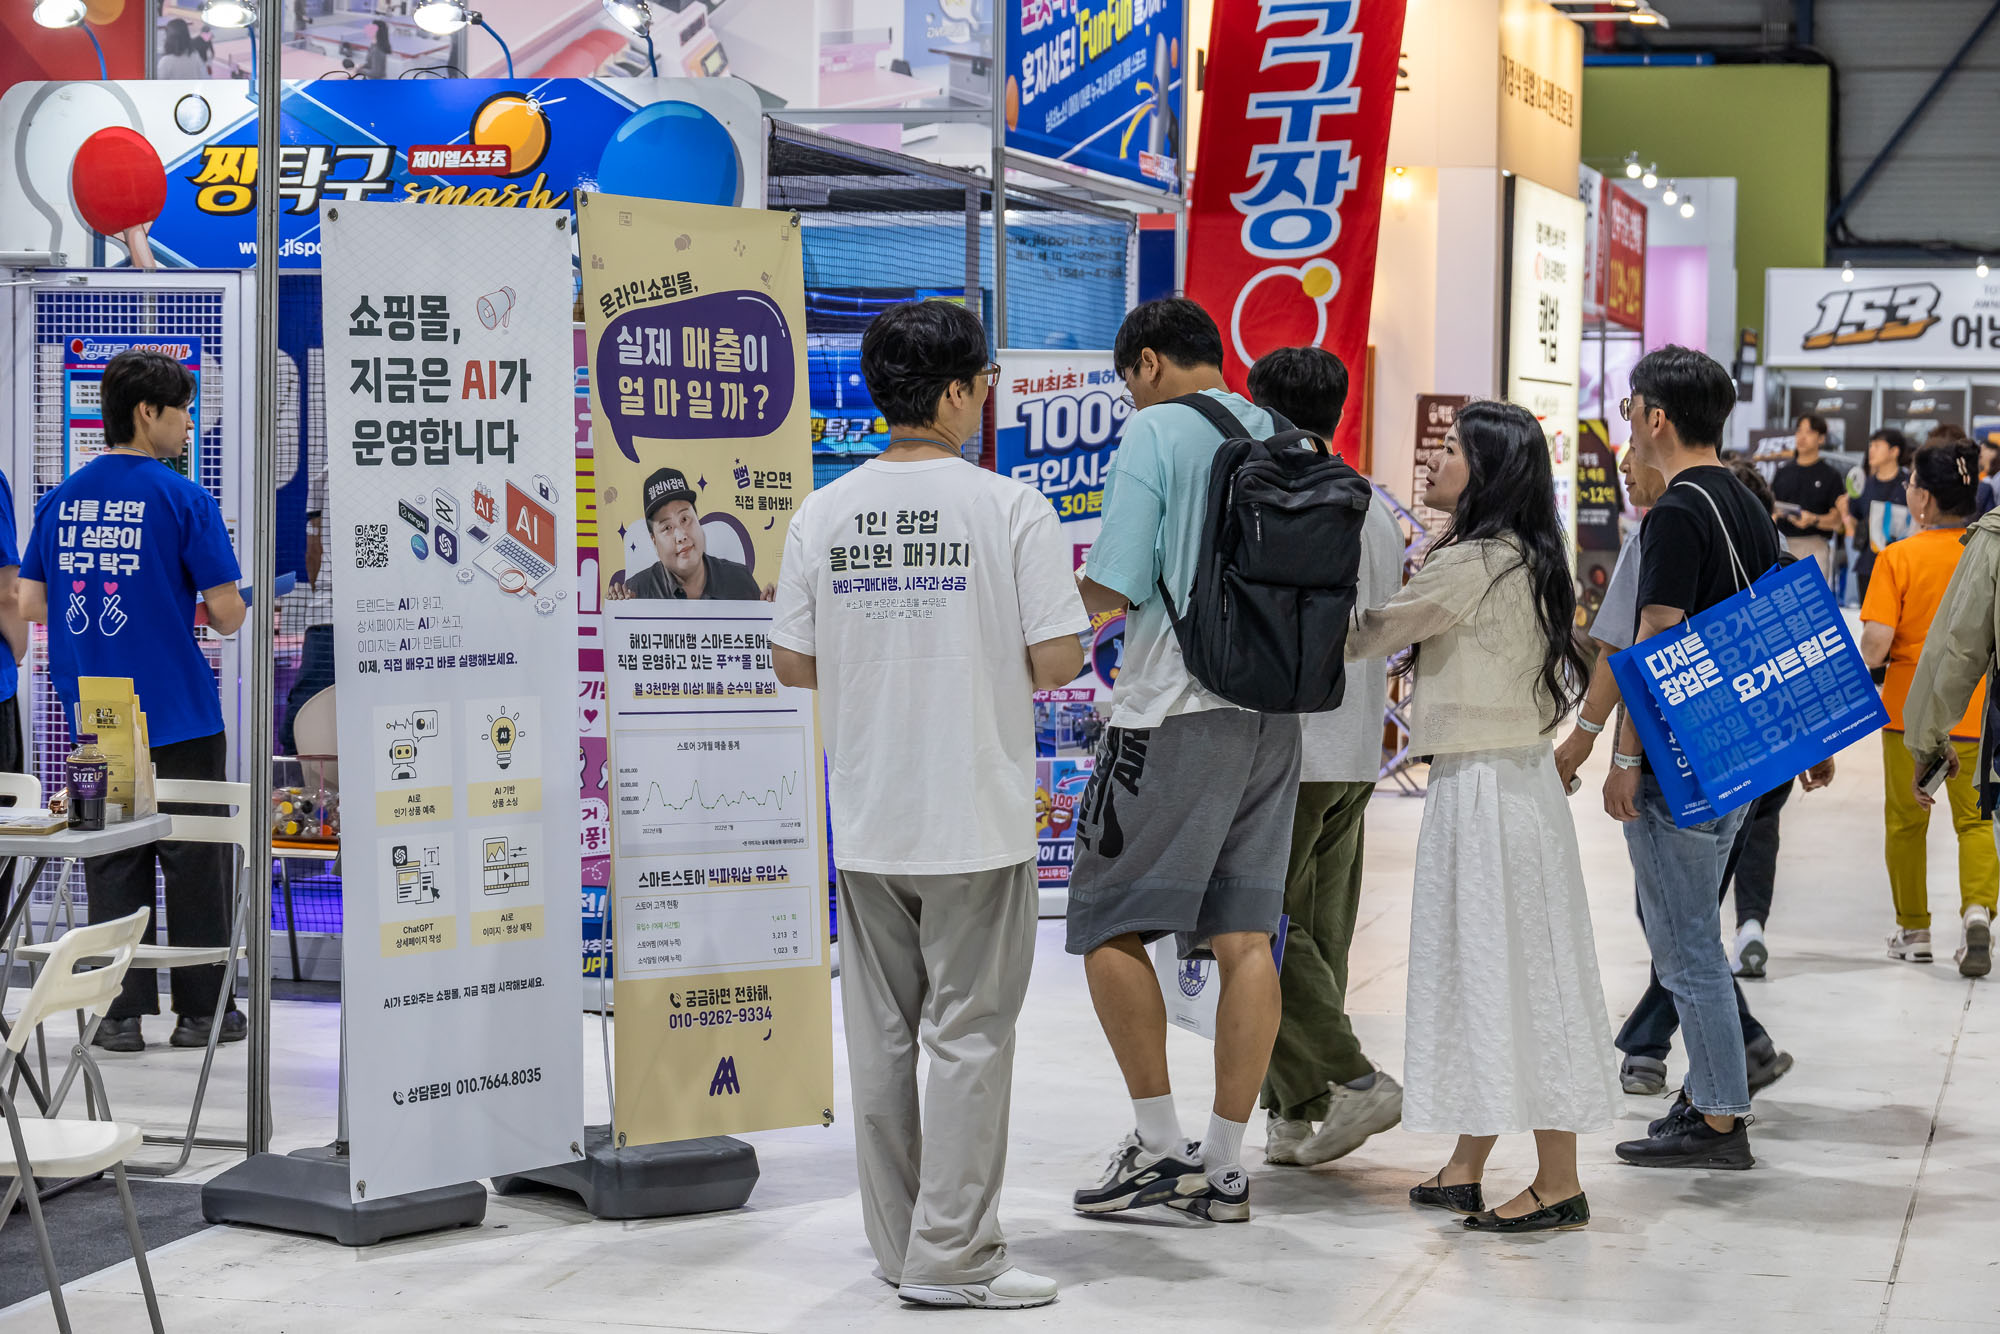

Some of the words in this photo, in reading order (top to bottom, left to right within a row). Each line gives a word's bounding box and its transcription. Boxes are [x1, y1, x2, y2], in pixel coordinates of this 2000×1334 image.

[1022, 26, 1076, 105] 혼자서도!
[411, 148, 507, 169] 제이엘스포츠
[599, 271, 699, 319] 온라인쇼핑몰,
[349, 295, 461, 345] 쇼핑몰,
[1802, 283, 1941, 350] 153
[616, 325, 672, 367] 실제
[682, 326, 768, 374] 매출이
[349, 357, 451, 404] 지금은
[461, 358, 532, 403] AI가
[1012, 371, 1084, 395] 국내최초!
[1087, 369, 1115, 385] 특허
[352, 418, 519, 466] 운영합니다
[648, 478, 686, 500] 월천N잡러
[733, 464, 751, 489] 뻥
[752, 471, 792, 490] 같으면
[58, 499, 99, 522] 너를
[104, 500, 146, 523] 보면
[476, 498, 490, 519] AI
[735, 495, 754, 510] 직접
[757, 495, 793, 511] 물어봐!
[515, 505, 538, 545] AI
[854, 511, 887, 536] 1인
[896, 510, 938, 535] 창업
[58, 526, 76, 548] 내
[81, 526, 142, 550] 심장이
[58, 553, 95, 574] 탁구
[100, 553, 140, 576] 탁구
[829, 543, 892, 572] 올인원
[902, 542, 969, 567] 패키지
[832, 577, 901, 595] 해외구매대행,
[904, 576, 939, 591] 시작과
[941, 576, 967, 591] 성공
[356, 599, 395, 612] 트렌드는
[398, 597, 420, 610] AI가
[423, 597, 444, 610] 읽고,
[1704, 572, 1822, 650] 요거트월드
[357, 619, 416, 633] 상세페이지는
[417, 617, 439, 630] AI가
[442, 615, 464, 629] 쓰고,
[358, 639, 397, 653] 이미지는
[399, 638, 421, 651] AI가
[629, 633, 697, 650] 해외구매대행
[1718, 599, 1834, 676] 요거트월드
[358, 660, 381, 674] 이제,
[383, 659, 403, 672] 직접
[405, 657, 434, 671] 배우고
[437, 655, 456, 669] 바로
[458, 652, 518, 668] 실행해보세요.
[618, 654, 638, 670] 직접
[642, 654, 687, 670] 운영하고
[691, 654, 712, 670] 있는
[1645, 632, 1710, 681] 디저트
[1660, 658, 1723, 706] 창업은
[1732, 625, 1847, 703] 요거트월드
[634, 682, 643, 697] 월
[646, 682, 680, 696] 3천만원
[683, 682, 704, 695] 이상!
[706, 682, 724, 695] 매출
[727, 682, 752, 695] 순수익
[755, 681, 776, 695] 달성!
[1748, 652, 1858, 728] 요거트월드
[1762, 680, 1870, 754] 요거트월드
[638, 869, 705, 889] 스마트스토어
[708, 866, 752, 884] 빅파워샵
[755, 865, 788, 882] 유입수
[635, 901, 653, 911] 스토어
[653, 901, 666, 910] 고객
[666, 900, 679, 910] 현황
[403, 923, 434, 935] ChatGPT
[383, 996, 401, 1010] AI가
[403, 992, 434, 1006] 도와주는
[436, 988, 461, 1001] 쇼핑몰,
[463, 985, 479, 998] 지금
[480, 983, 496, 995] 직접
[498, 976, 545, 993] 시작해보세요.
[685, 988, 731, 1008] 궁금하면
[734, 984, 772, 1003] 전화해,
[669, 1006, 773, 1029] 010-9262-9334
[407, 1081, 451, 1103] 상담문의
[456, 1067, 541, 1095] 010.7664.8035
